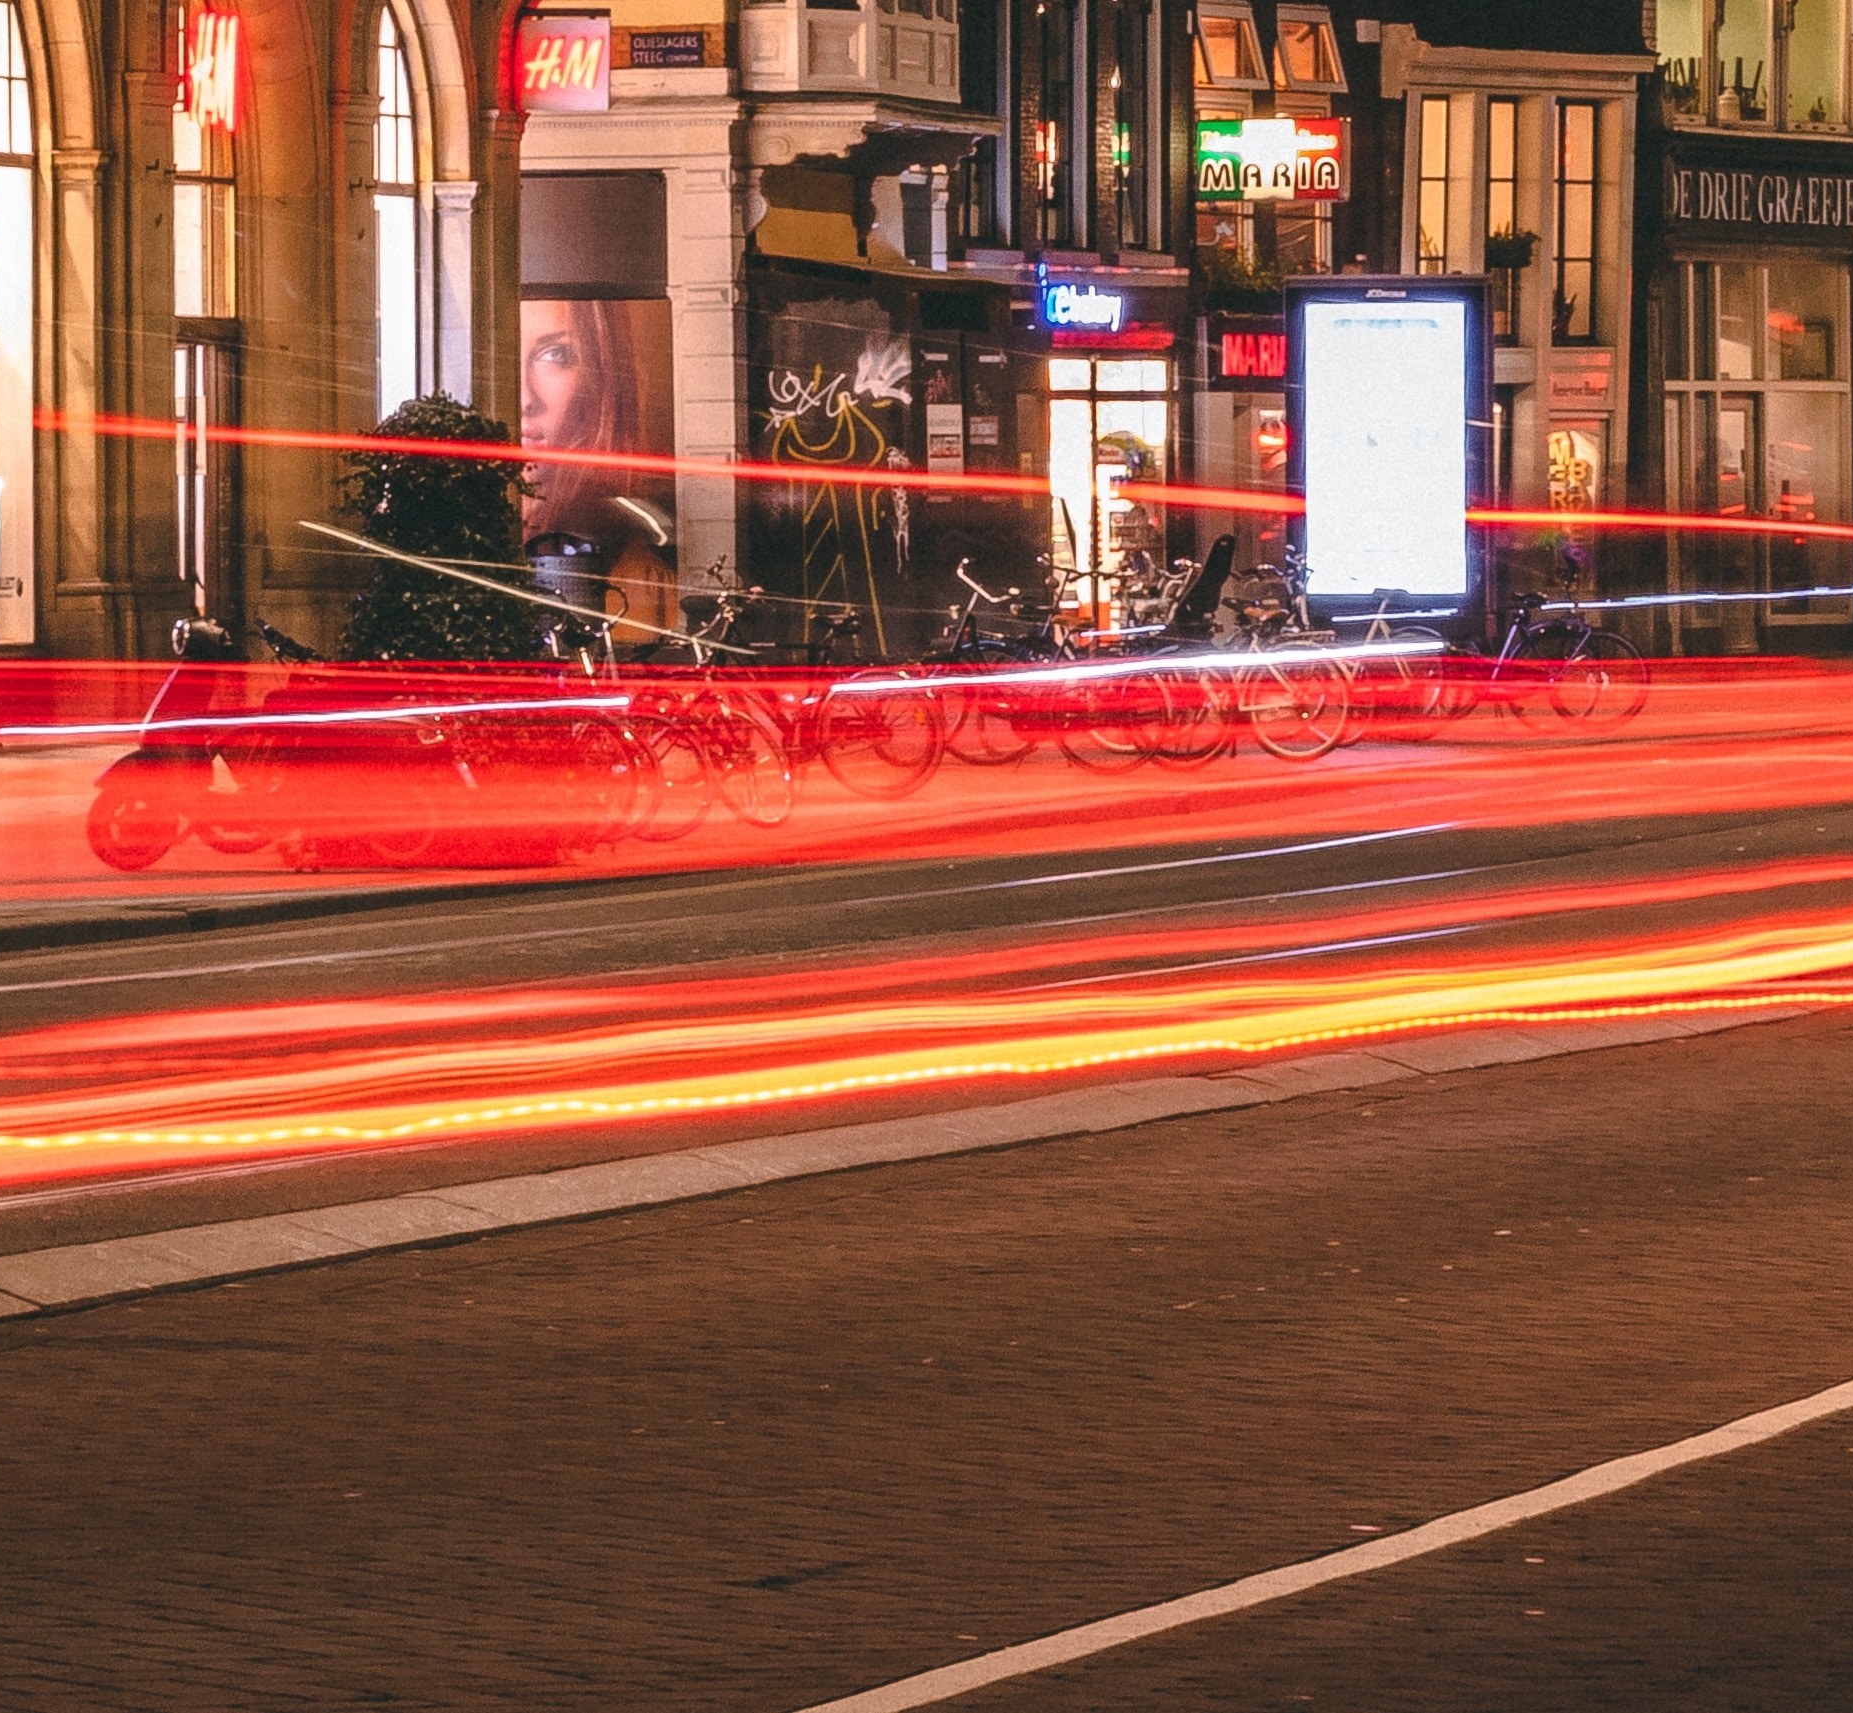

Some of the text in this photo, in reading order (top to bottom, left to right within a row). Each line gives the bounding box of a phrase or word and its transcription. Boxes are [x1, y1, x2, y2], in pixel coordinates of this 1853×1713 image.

[525, 38, 603, 90] H&M
[633, 51, 664, 65] STEEG
[1198, 157, 1340, 191] MARIA
[1699, 171, 1753, 222] DRIE
